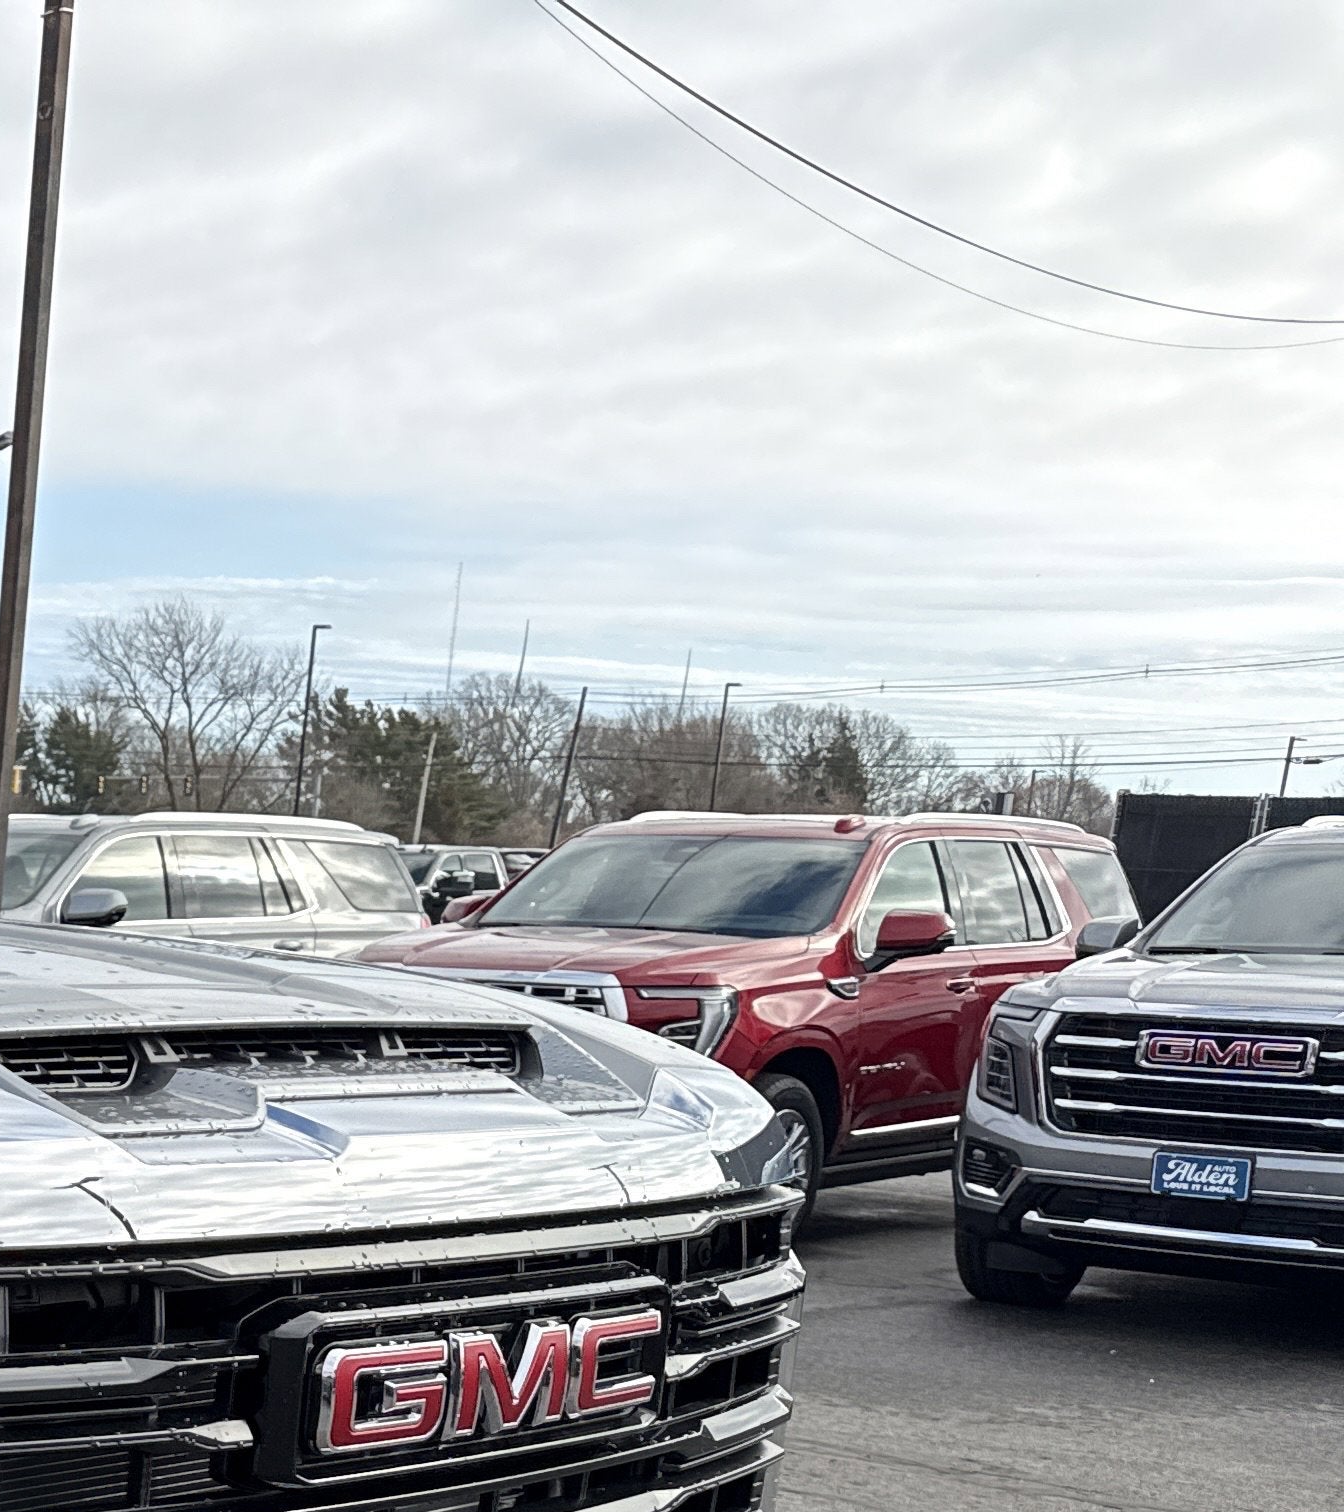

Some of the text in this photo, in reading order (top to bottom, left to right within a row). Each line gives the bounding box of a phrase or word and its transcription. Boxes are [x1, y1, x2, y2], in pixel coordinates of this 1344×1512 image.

[1148, 1037, 1304, 1069] GMC
[1162, 1159, 1239, 1186] Alden
[1213, 1164, 1237, 1174] AUTO
[1163, 1181, 1236, 1194] LOVE IT LOCAL
[315, 1309, 662, 1454] GMC
